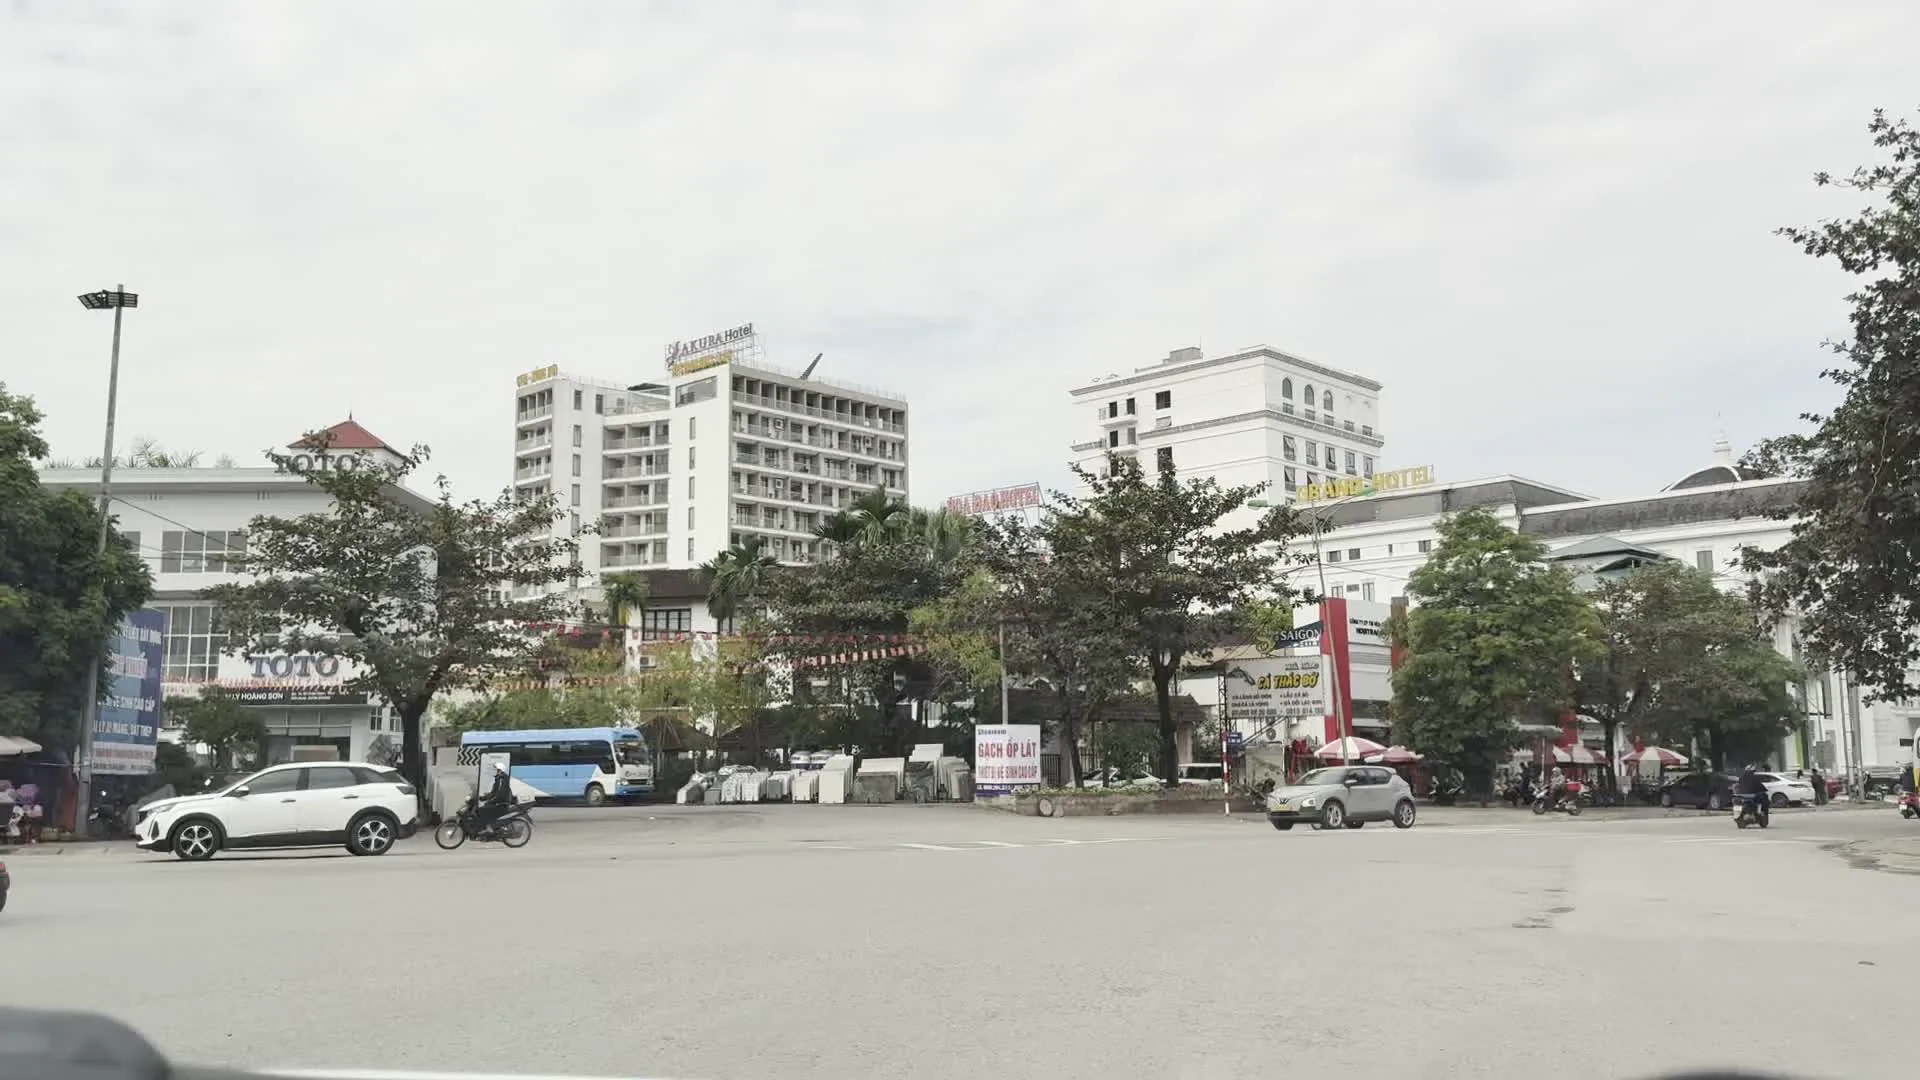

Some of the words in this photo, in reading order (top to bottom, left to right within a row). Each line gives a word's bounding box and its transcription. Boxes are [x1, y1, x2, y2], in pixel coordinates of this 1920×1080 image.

[724, 322, 752, 341] Hotel
[1372, 464, 1435, 490] HOTEL
[1280, 629, 1321, 641] SAIGON
[250, 655, 339, 678] TOTO
[1258, 673, 1271, 689] CÁ
[1274, 672, 1300, 689] THÁC
[978, 742, 1003, 760] GẠCH
[1007, 736, 1019, 758] ỐP
[1021, 738, 1037, 758] LÁT
